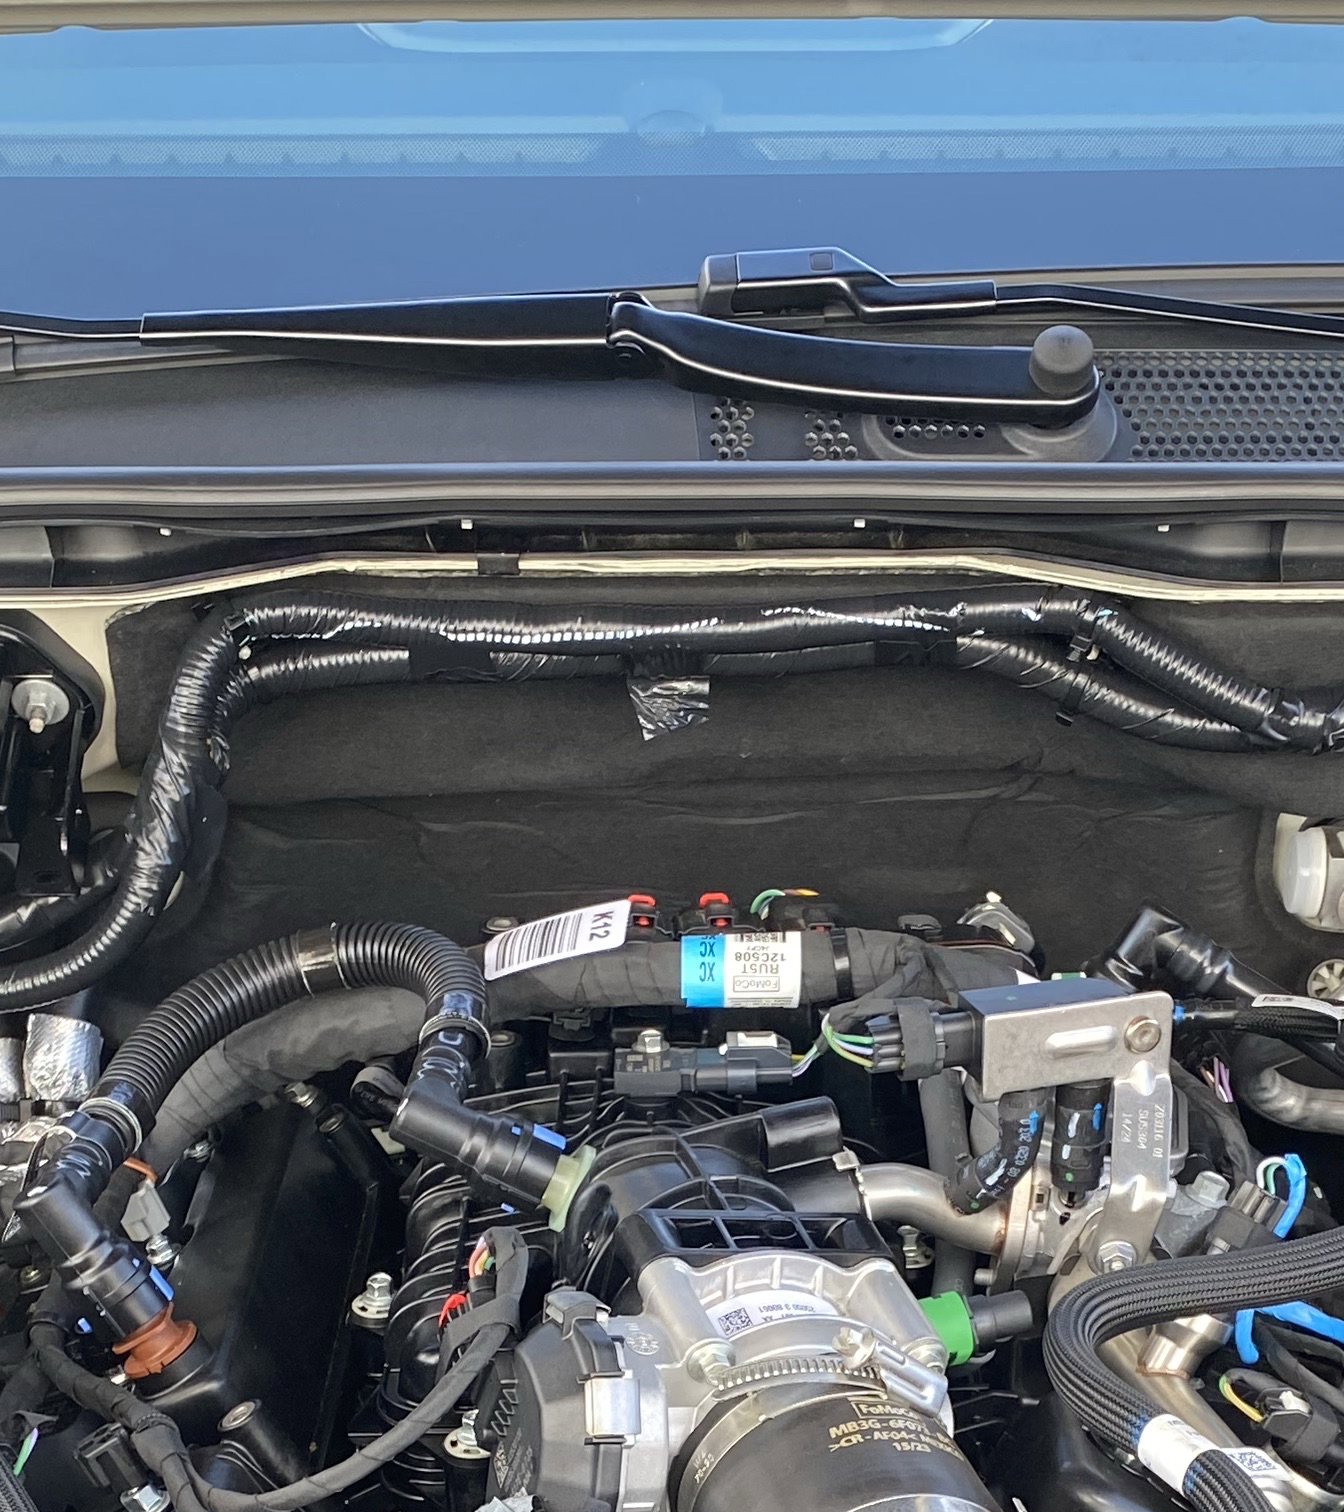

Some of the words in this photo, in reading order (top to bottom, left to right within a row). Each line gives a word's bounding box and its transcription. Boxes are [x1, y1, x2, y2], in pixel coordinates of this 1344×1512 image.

[588, 910, 615, 942] K12
[734, 951, 787, 963] 12C508
[699, 961, 716, 982] XC
[734, 979, 779, 989] FoMoCo
